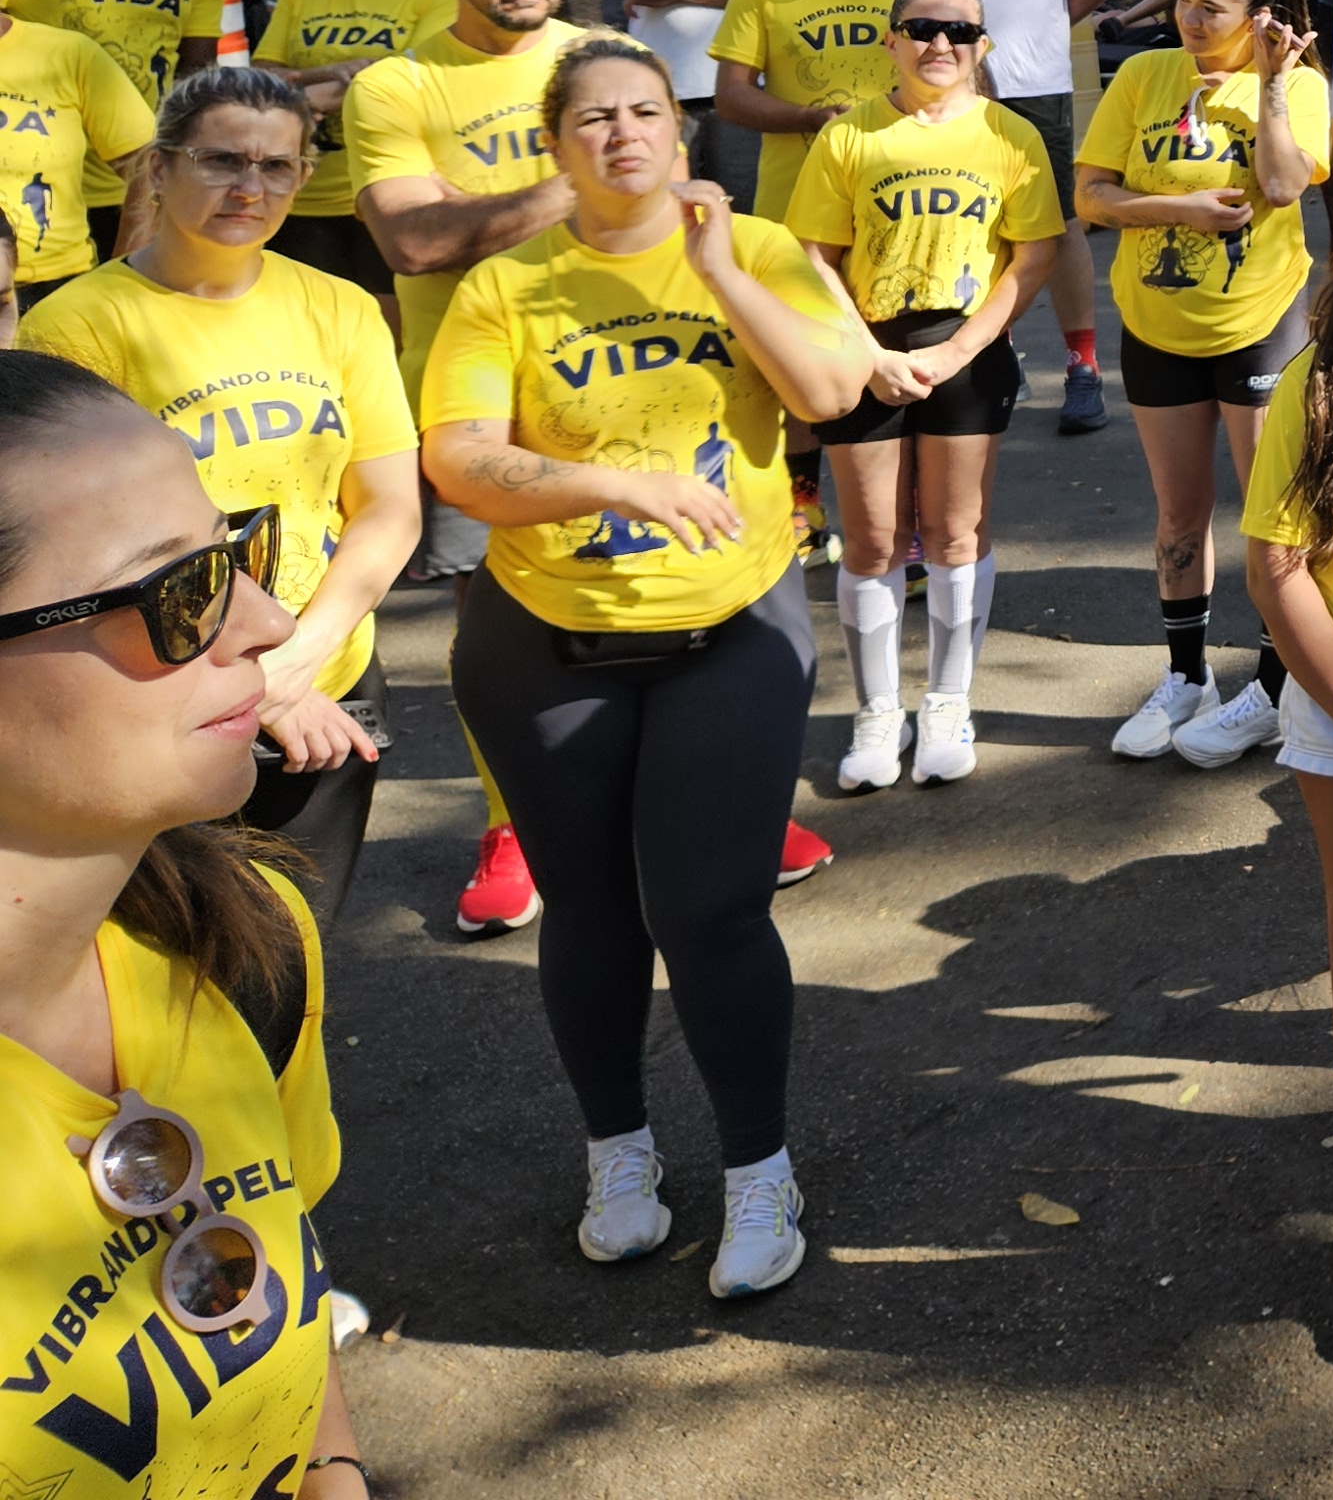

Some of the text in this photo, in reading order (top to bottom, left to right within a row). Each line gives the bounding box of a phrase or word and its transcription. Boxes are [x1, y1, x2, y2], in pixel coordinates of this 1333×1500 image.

[794, 5, 890, 28] VIBRANDO PE
[302, 26, 395, 50] VIDA
[799, 23, 887, 51] VID
[463, 126, 547, 166] VID
[1141, 135, 1249, 168] VIDA
[870, 168, 990, 194] VIBRANDO PELA
[873, 187, 987, 224] VIDA
[545, 311, 718, 355] VIBRANDO PELA
[552, 331, 736, 390] VIDA
[159, 370, 331, 422] VIBRANDO PELA
[174, 398, 346, 461] VIDA
[36, 599, 99, 625] OAKLEY
[203, 1157, 297, 1213] PEL
